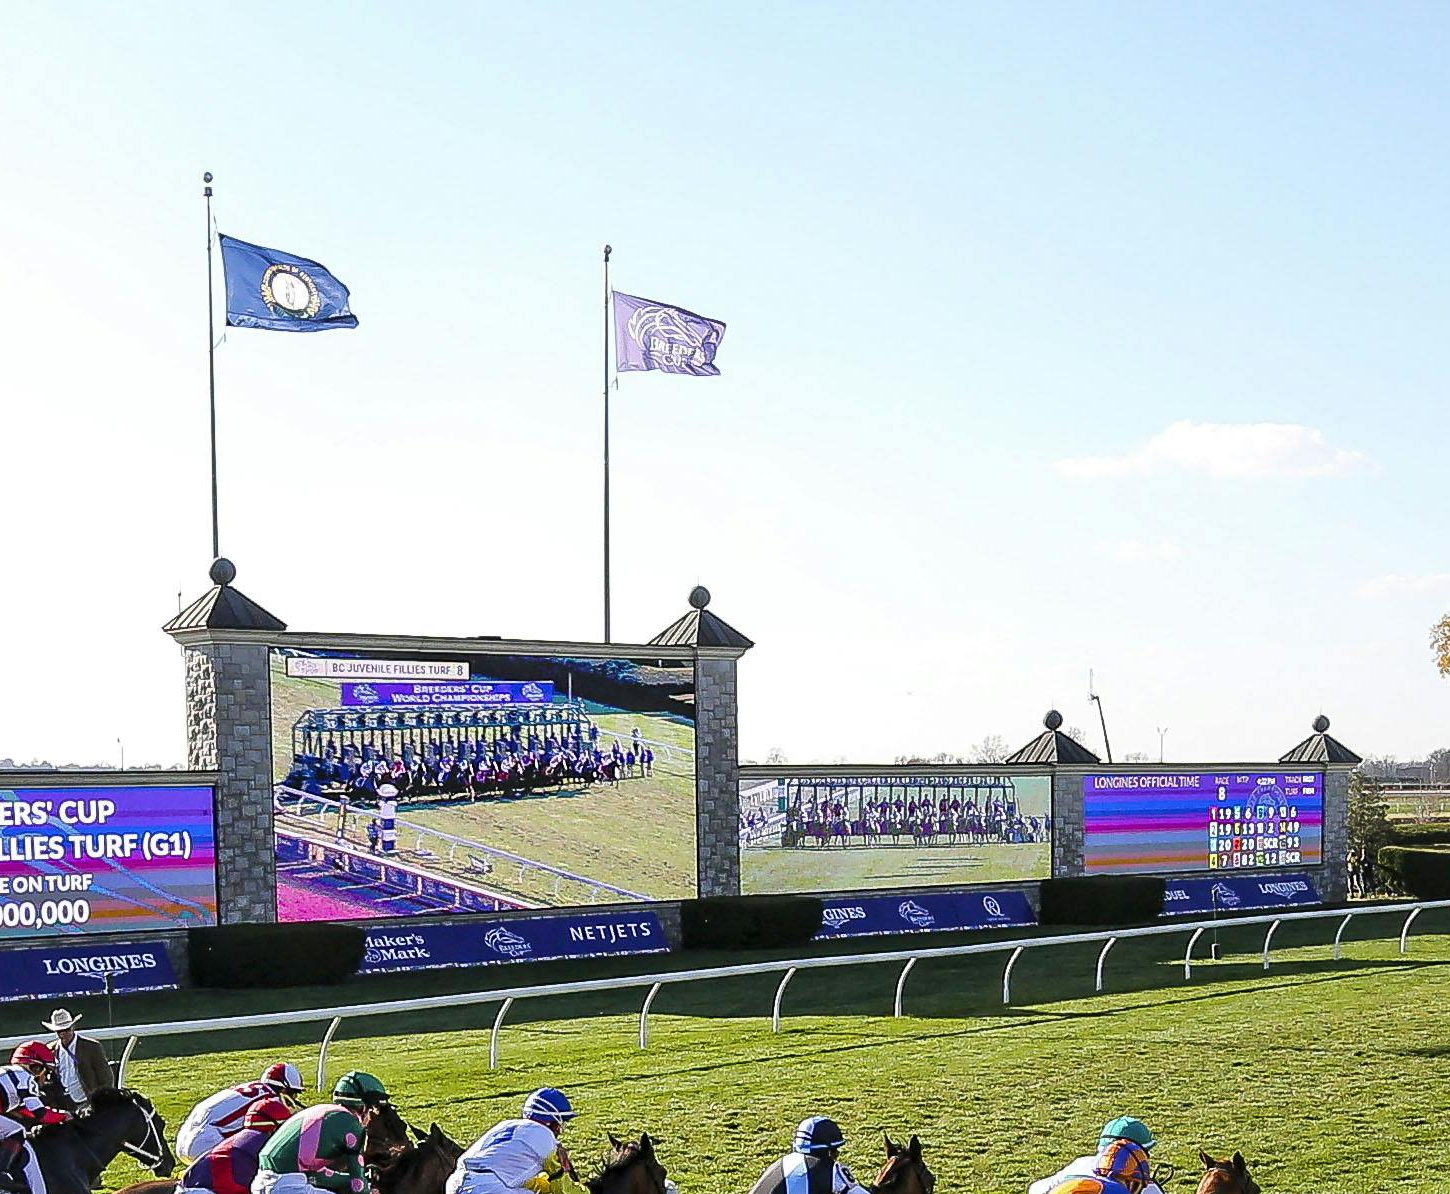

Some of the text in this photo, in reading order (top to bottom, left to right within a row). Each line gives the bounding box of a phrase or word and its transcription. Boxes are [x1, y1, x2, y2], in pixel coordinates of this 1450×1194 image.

[347, 665, 391, 675] JUVENILE
[393, 666, 427, 675] FILLIES
[457, 666, 464, 676] 8
[1094, 775, 1200, 789] LONGINES OFFICIAL TIME
[1217, 786, 1227, 801] 8
[60, 799, 116, 825] CUP
[71, 832, 139, 861] TURF
[141, 829, 192, 863] (G1)
[12, 875, 41, 895] ON
[43, 872, 95, 894] TURF
[1258, 881, 1309, 894] LONGINES
[822, 906, 867, 922] GINES
[569, 922, 651, 943] NETJETS
[42, 953, 157, 976] LONGINES
